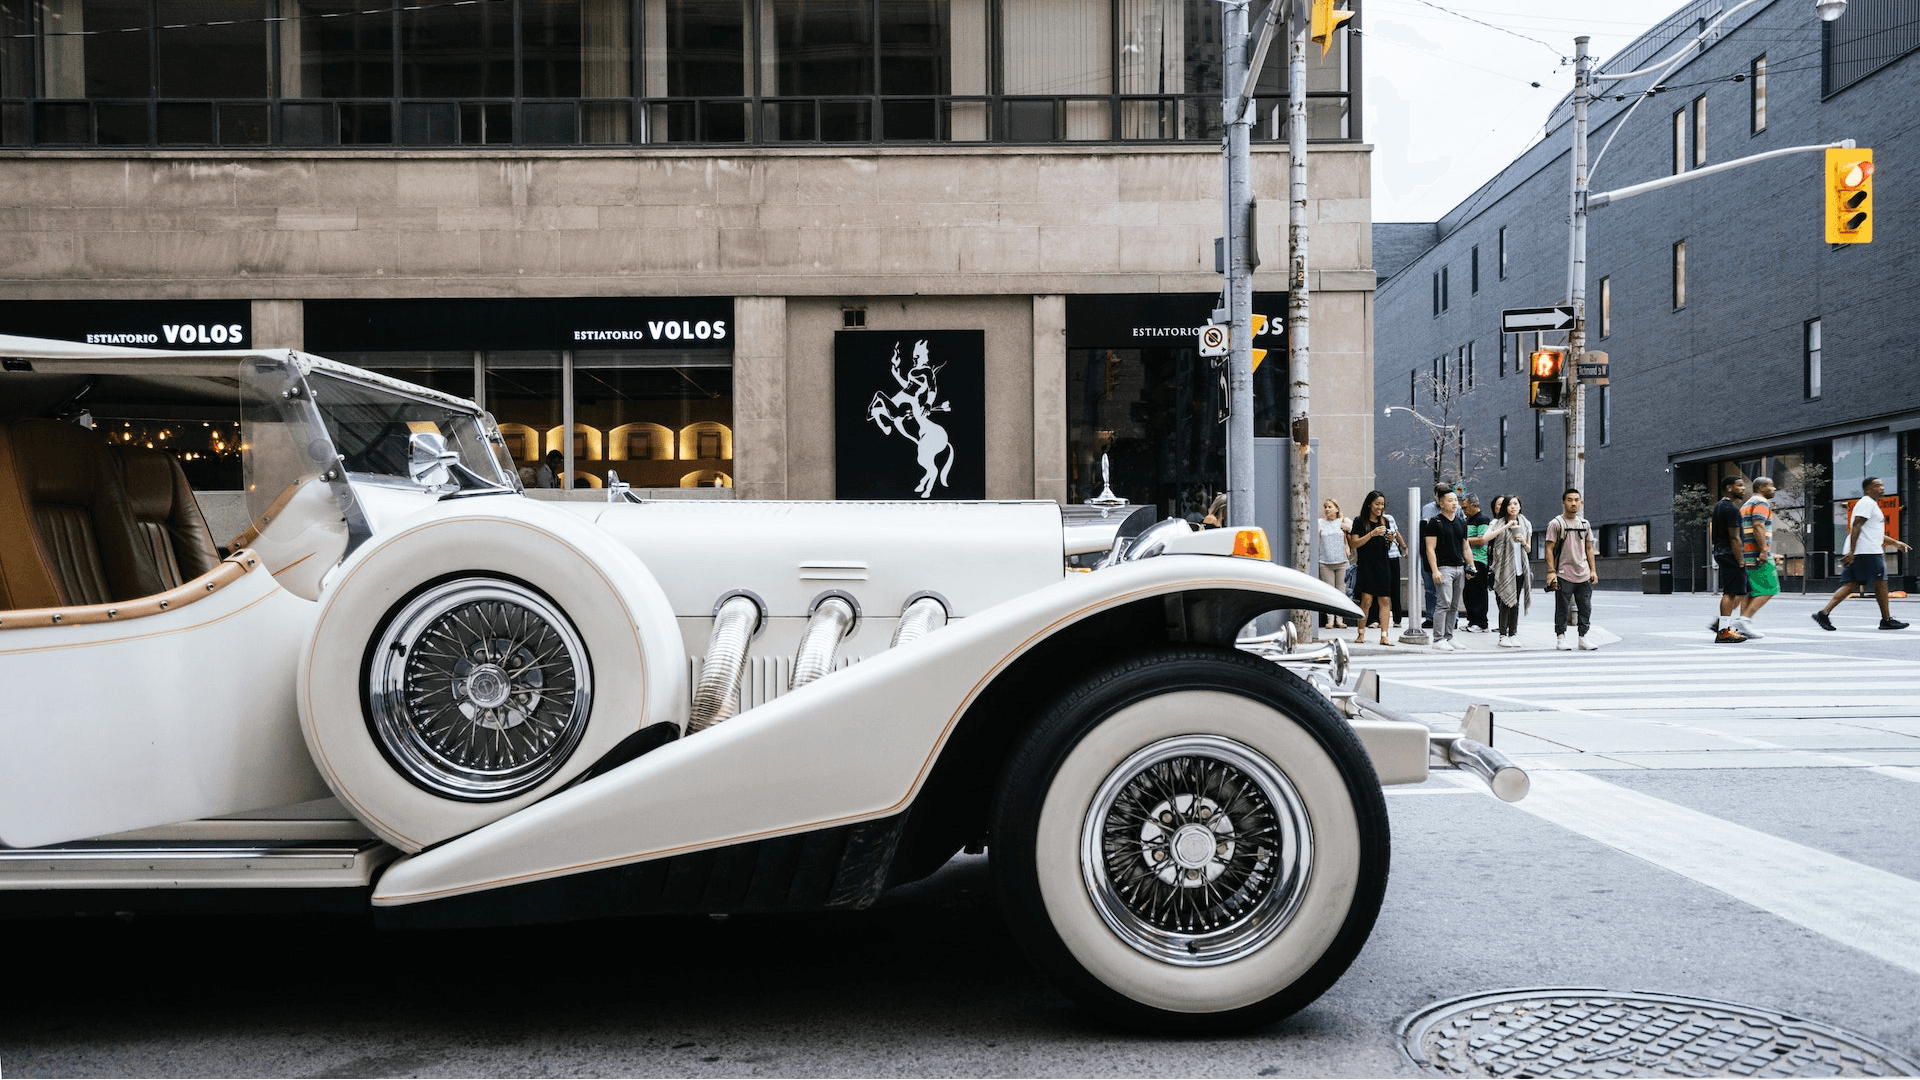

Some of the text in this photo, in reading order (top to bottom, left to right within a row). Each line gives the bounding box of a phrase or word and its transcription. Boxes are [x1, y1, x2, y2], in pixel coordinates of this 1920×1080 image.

[87, 324, 243, 344] ESTIATORIO VOLOS
[574, 320, 726, 340] ESTIATORIO VOLOS
[1132, 327, 1200, 337] ESTIATORIO
